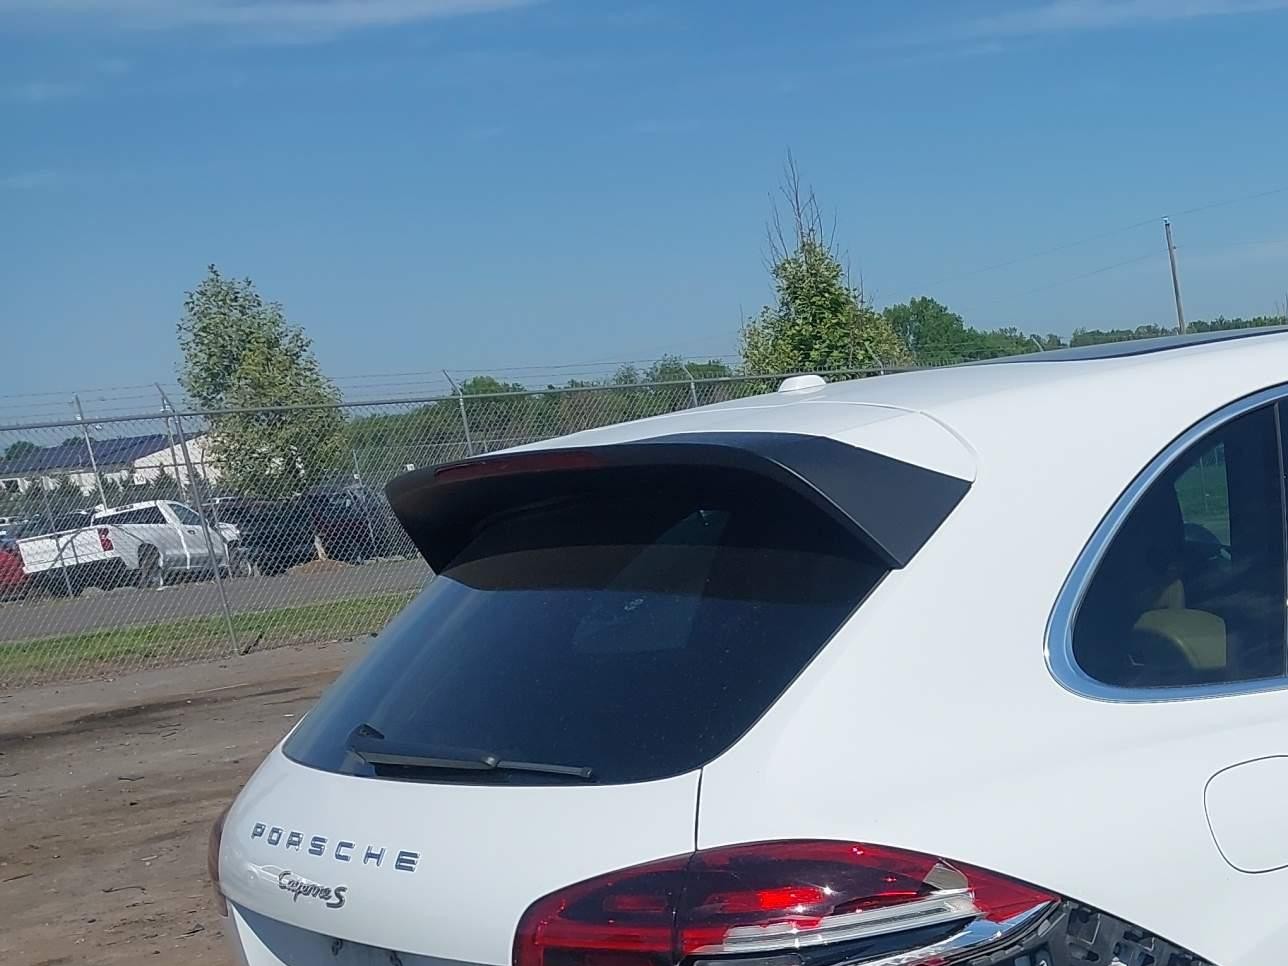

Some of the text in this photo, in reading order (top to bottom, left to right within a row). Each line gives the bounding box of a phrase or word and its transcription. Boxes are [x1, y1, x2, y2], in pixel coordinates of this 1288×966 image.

[251, 822, 420, 872] PORSCHE
[278, 870, 348, 909] Cayenne S
